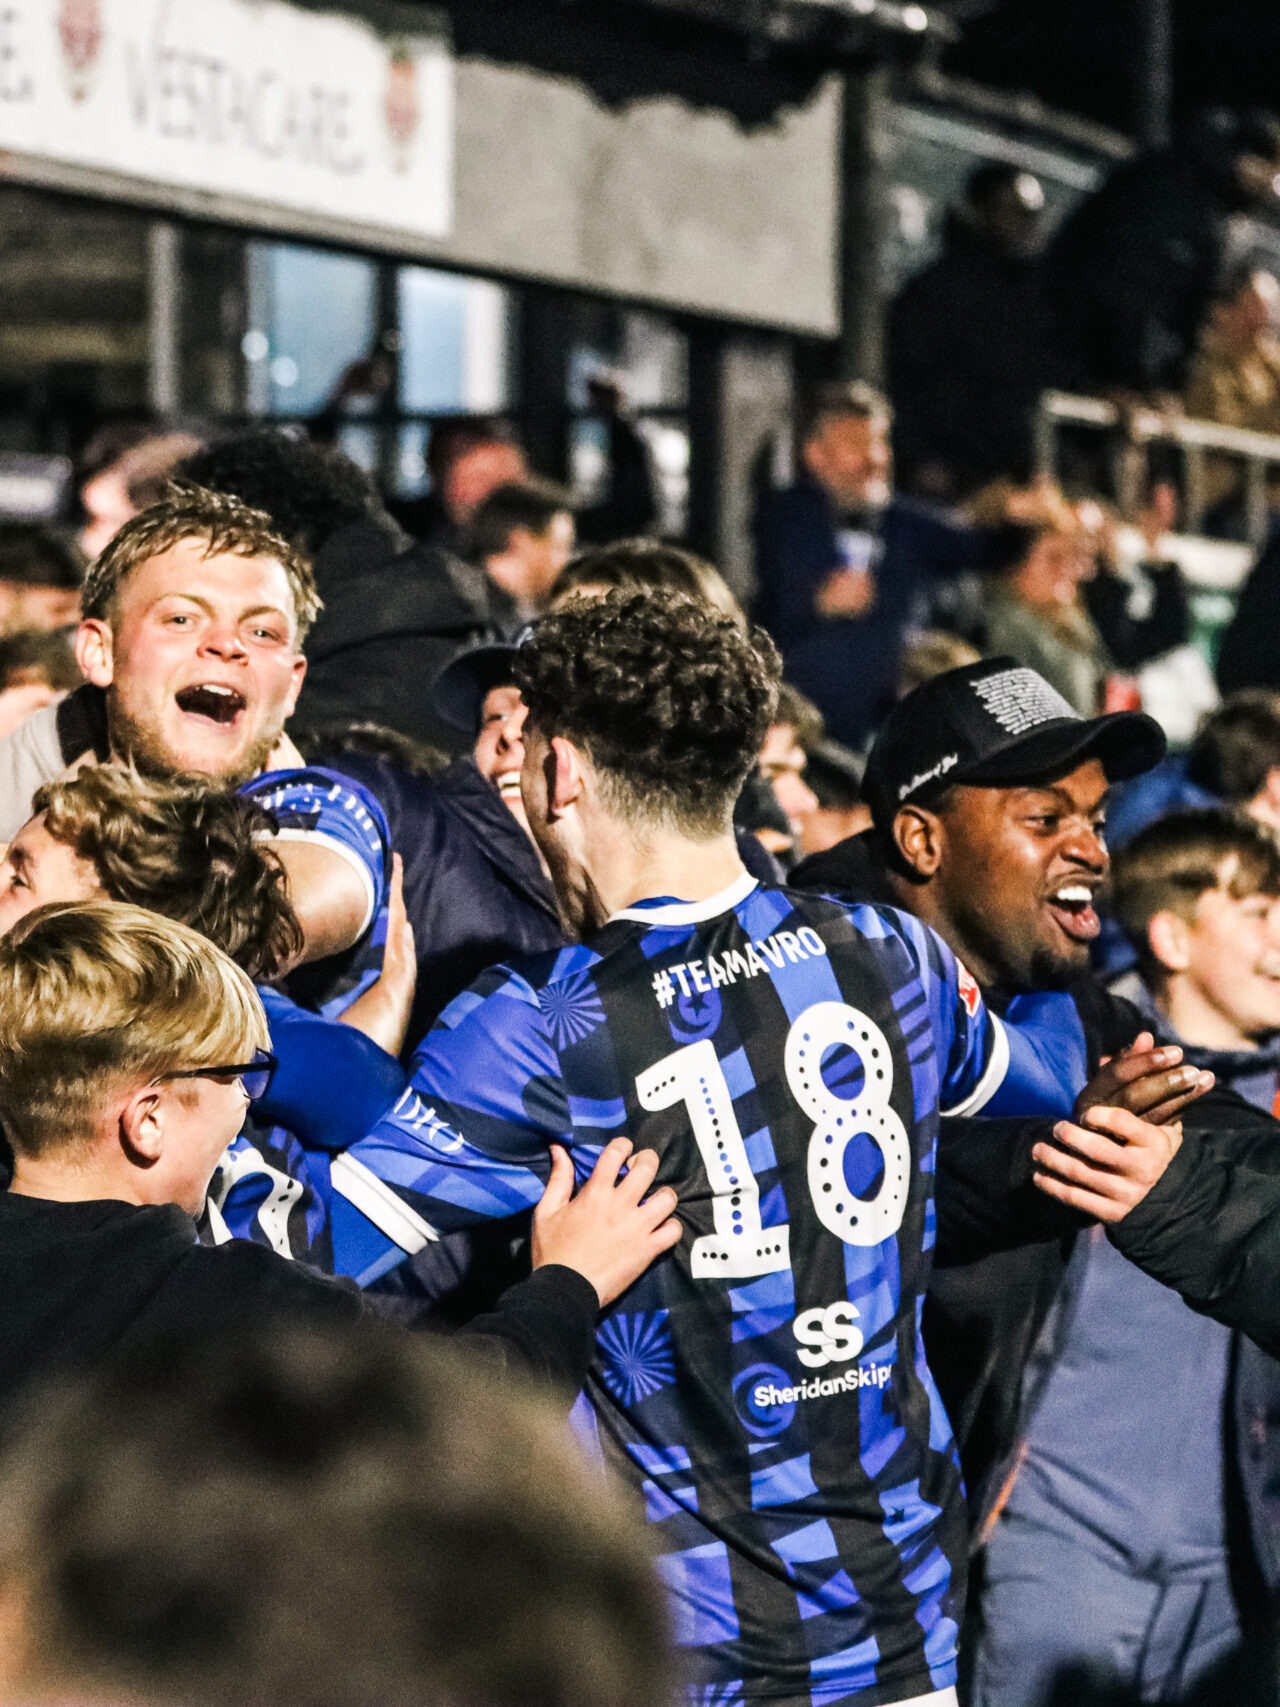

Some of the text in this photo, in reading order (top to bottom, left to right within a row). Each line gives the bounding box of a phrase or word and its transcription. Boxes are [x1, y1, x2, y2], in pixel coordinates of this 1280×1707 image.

[652, 926, 827, 1009] #TEAMAVRO
[635, 1001, 911, 1280] 18
[792, 1301, 864, 1369] SS
